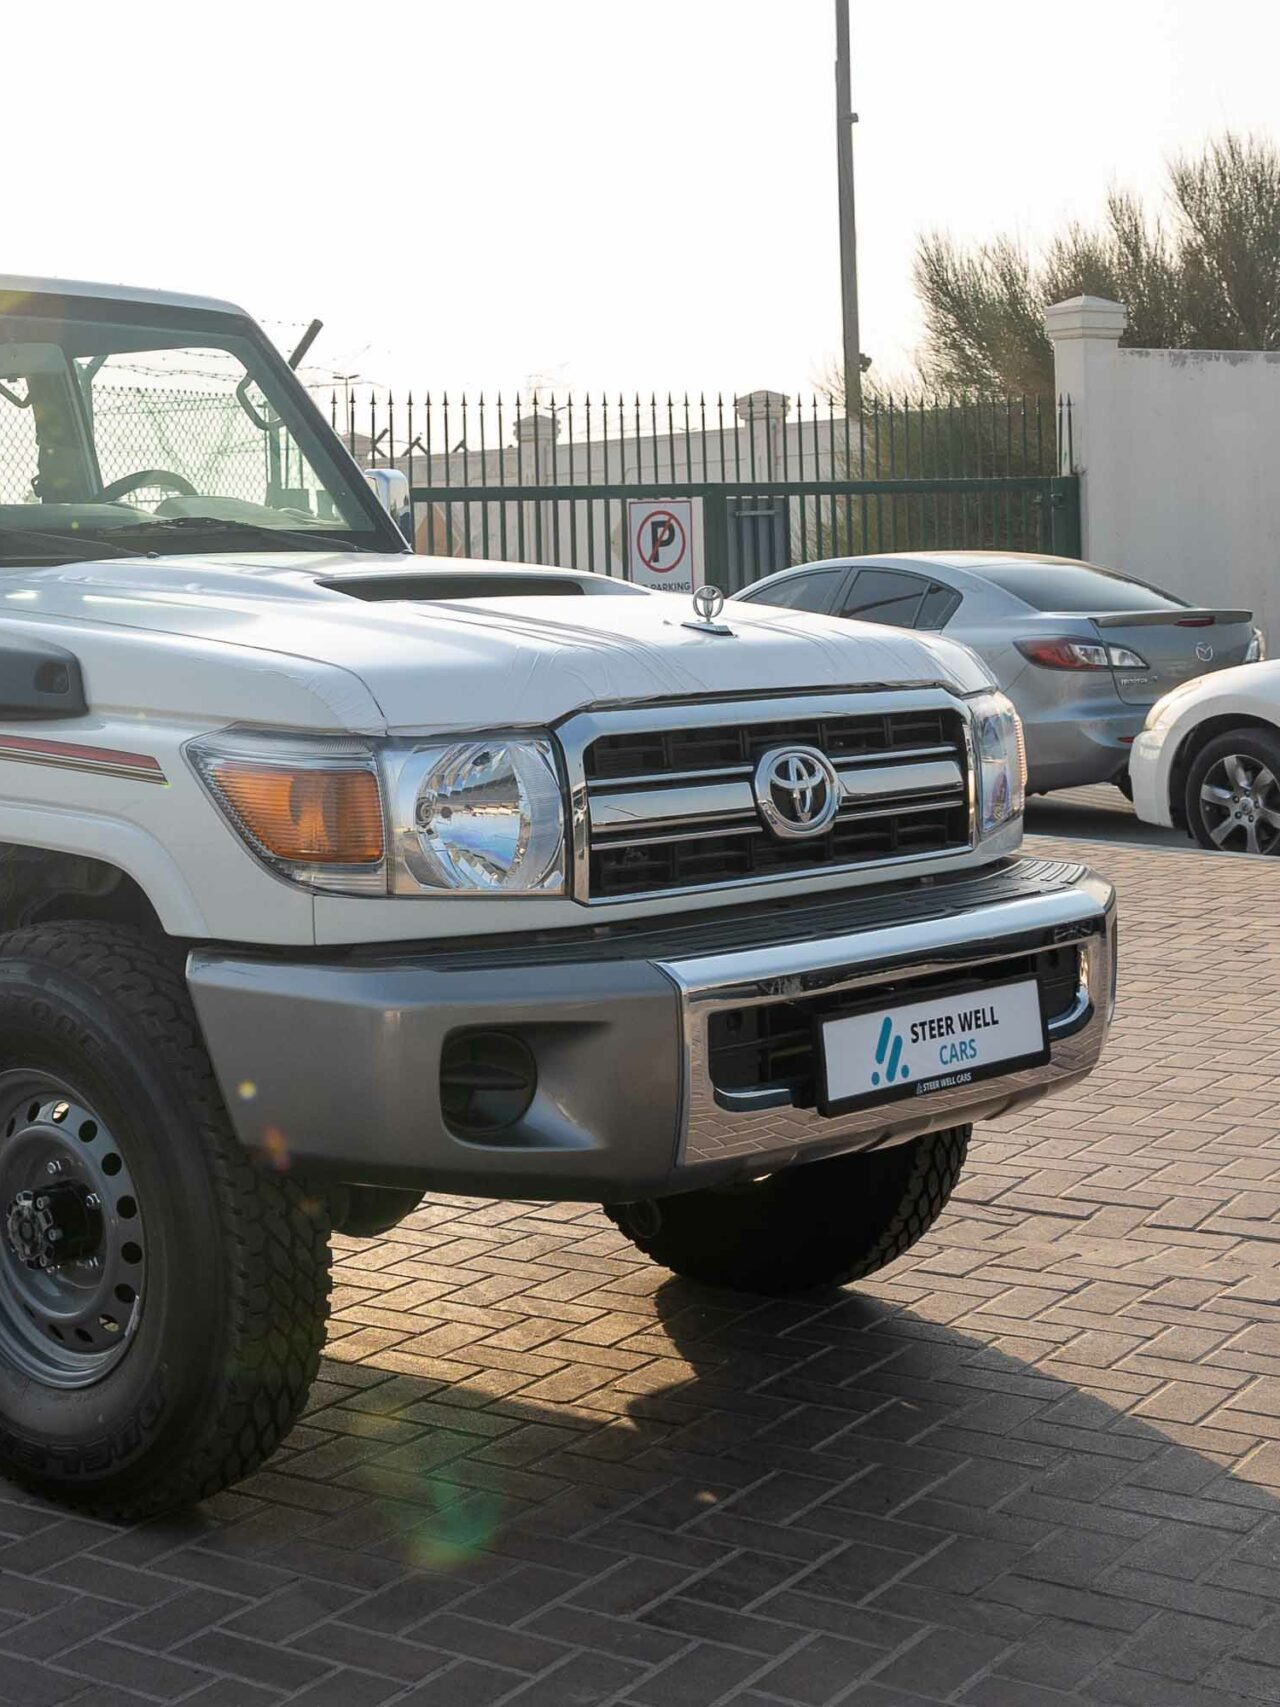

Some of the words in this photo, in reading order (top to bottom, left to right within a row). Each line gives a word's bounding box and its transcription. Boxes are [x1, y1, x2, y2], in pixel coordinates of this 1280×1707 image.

[910, 1016, 955, 1043] STEER
[958, 1006, 999, 1032] WELL
[939, 1039, 977, 1065] CARS
[923, 1080, 940, 1092] STEER
[940, 1076, 956, 1088] WELL
[956, 1072, 972, 1084] CARS
